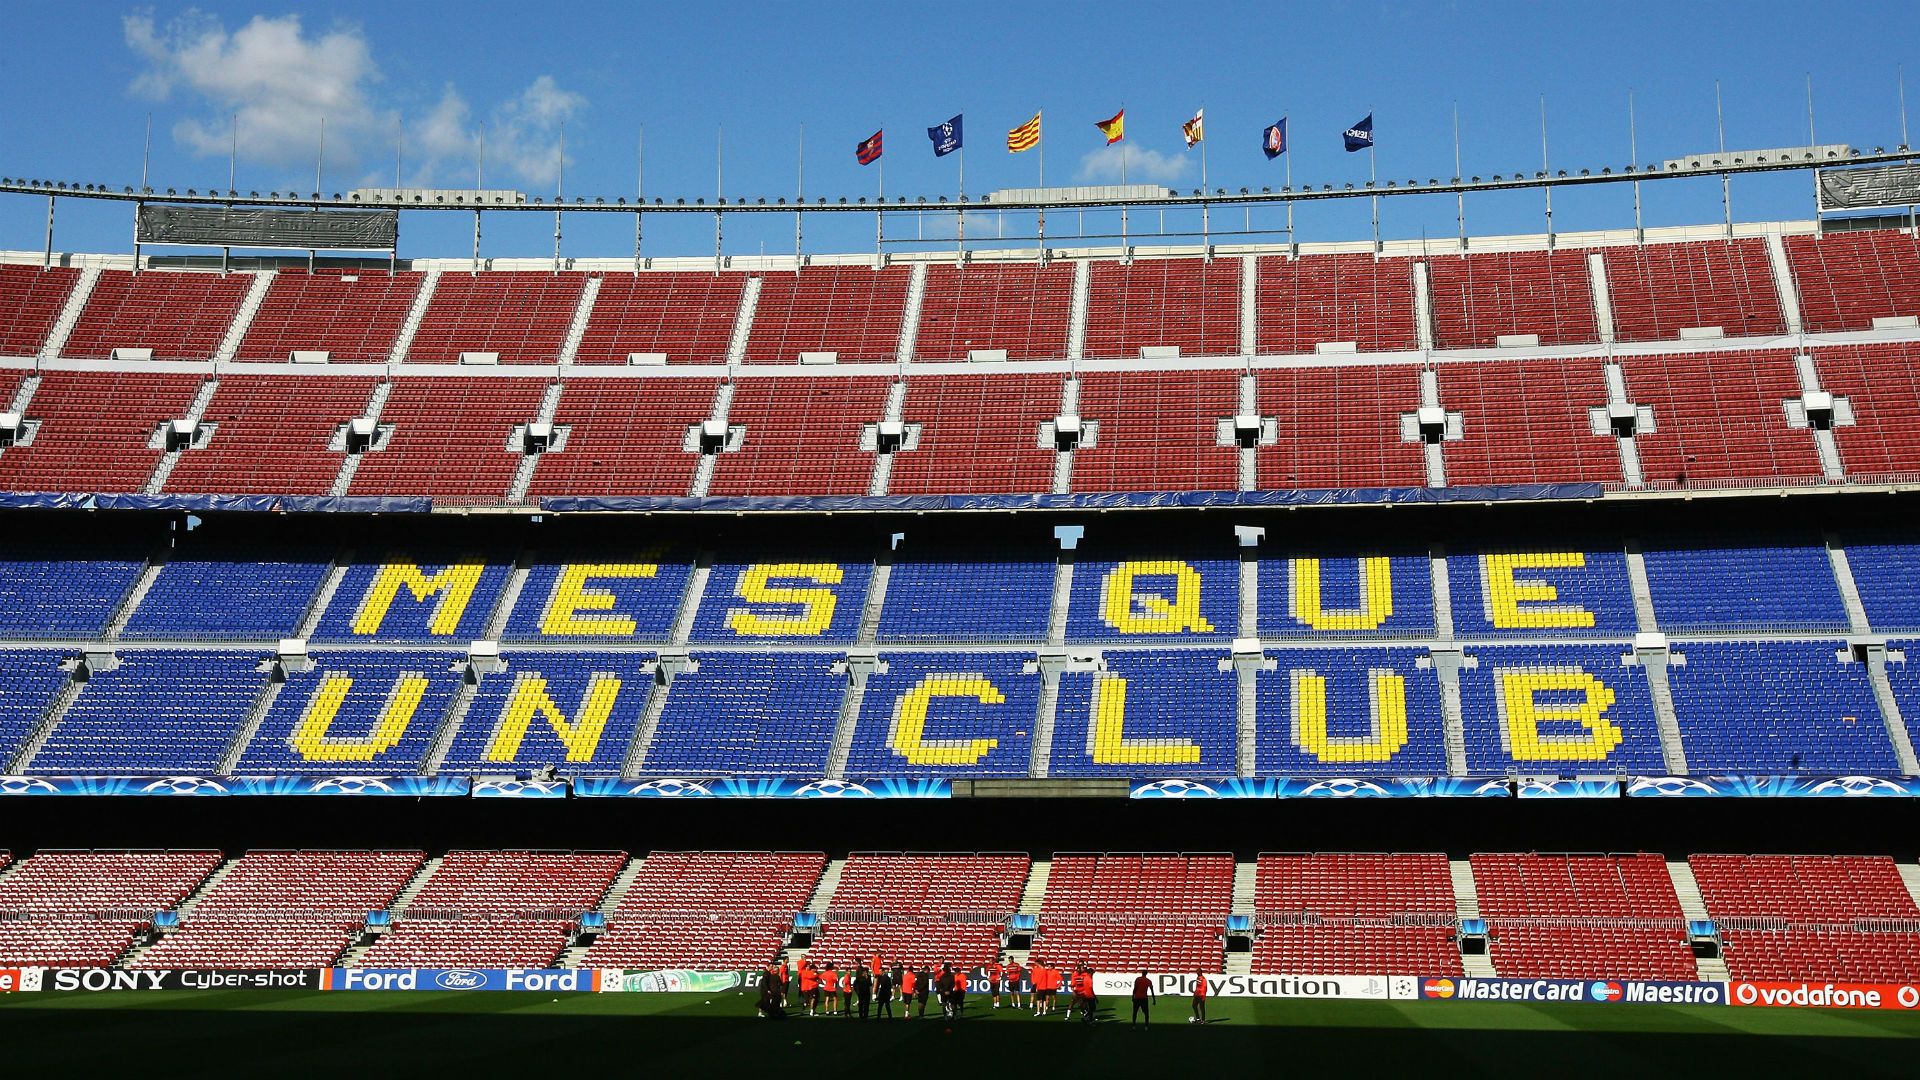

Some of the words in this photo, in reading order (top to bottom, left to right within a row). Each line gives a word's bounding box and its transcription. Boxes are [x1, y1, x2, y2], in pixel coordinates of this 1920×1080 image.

[1098, 550, 1596, 635] QUE
[283, 670, 622, 763] UN
[885, 665, 1623, 765] CLUB
[54, 969, 172, 991] SONY
[181, 970, 307, 989] Cyber-shot
[344, 969, 417, 990] Ford
[445, 970, 476, 986] Ford
[505, 969, 578, 991] Ford
[1104, 980, 1133, 989] SON
[1458, 979, 1584, 1001] MasterCard
[1626, 982, 1719, 1004] Maestro
[1760, 984, 1881, 1007] vodafone
